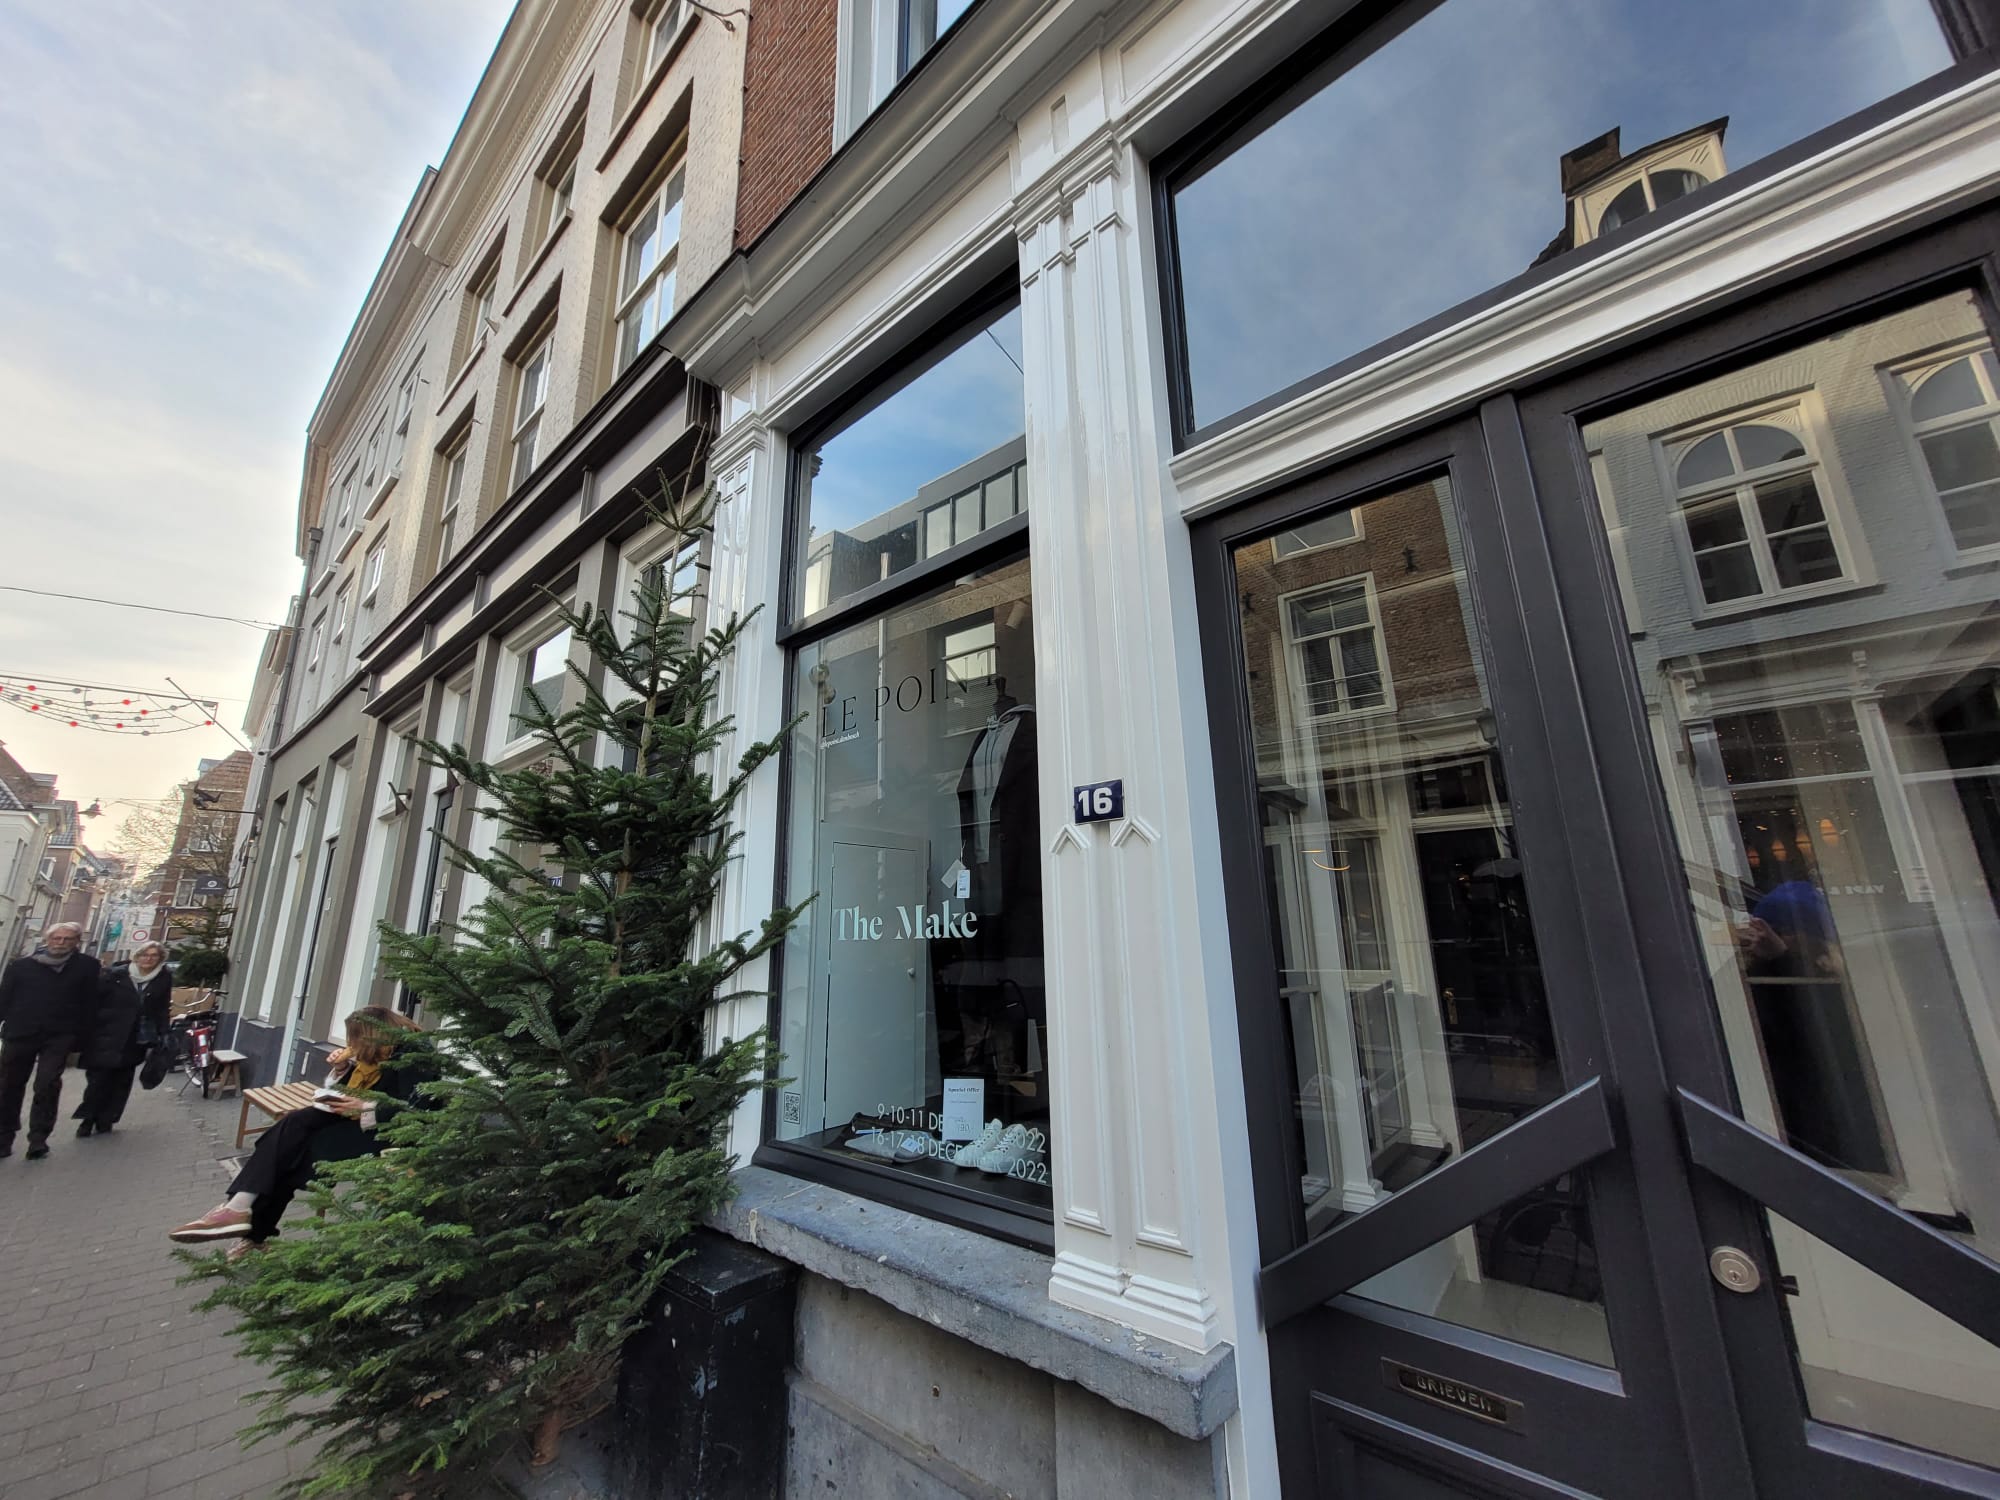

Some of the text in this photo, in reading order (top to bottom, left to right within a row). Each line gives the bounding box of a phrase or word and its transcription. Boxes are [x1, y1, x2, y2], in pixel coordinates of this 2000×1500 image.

[822, 696, 857, 738] LE
[1078, 787, 1113, 817] 16
[834, 900, 978, 941] The Make
[1007, 1156, 1047, 1184] 2022
